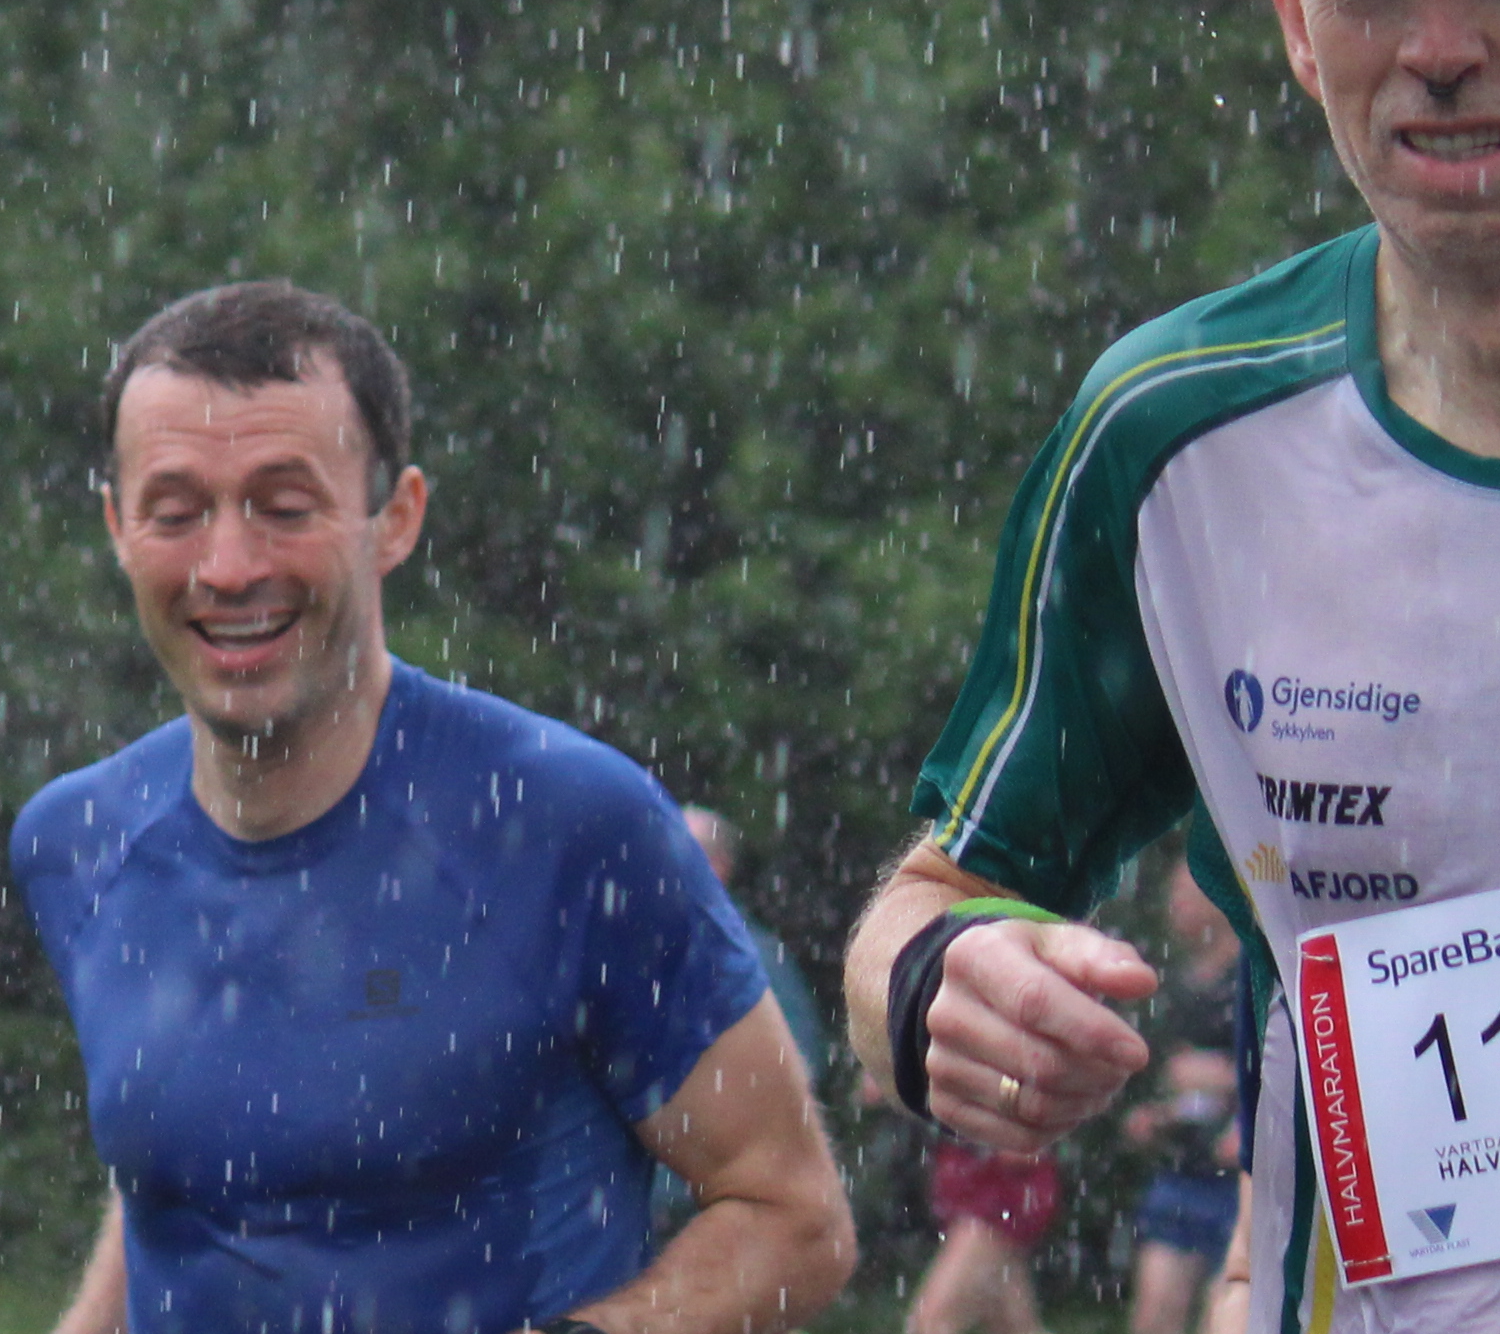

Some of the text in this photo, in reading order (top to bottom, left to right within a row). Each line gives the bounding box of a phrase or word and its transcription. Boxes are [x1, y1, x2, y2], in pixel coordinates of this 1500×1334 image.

[1271, 676, 1420, 722] Gjensidige
[1271, 720, 1335, 742] Sykkylven
[1290, 870, 1420, 901] AFJORD
[1310, 991, 1364, 1227] HALVMARATON
